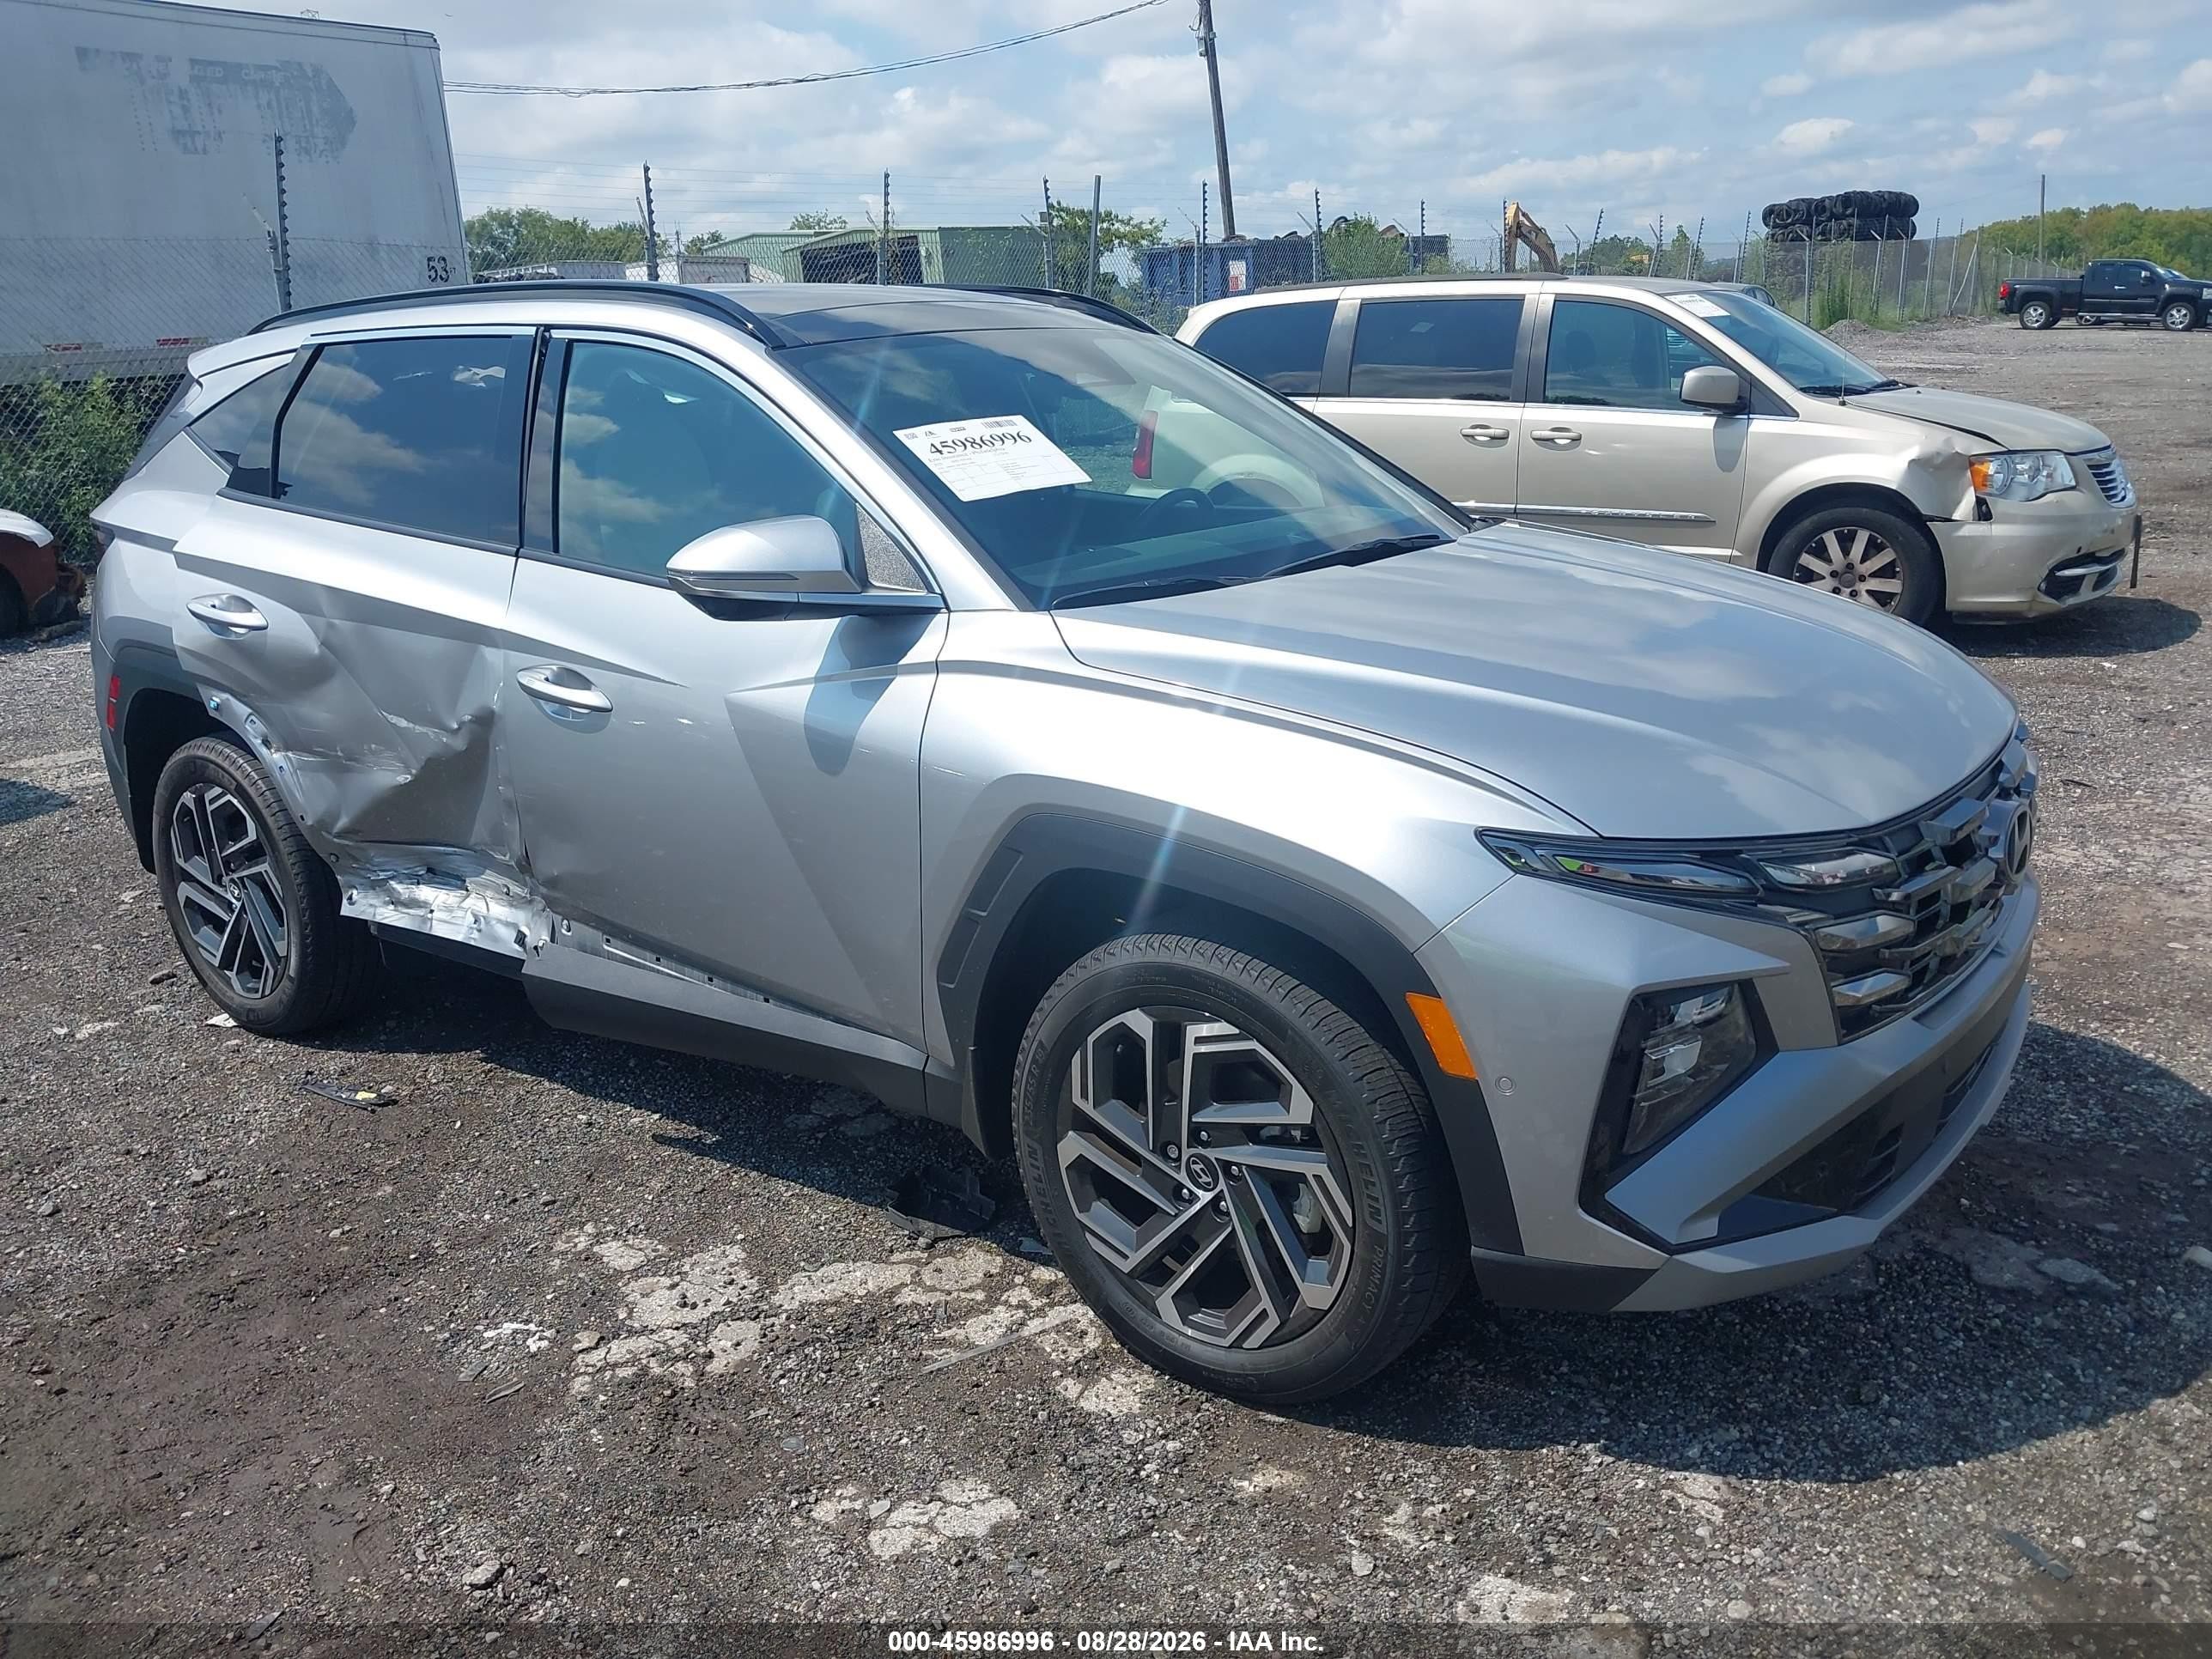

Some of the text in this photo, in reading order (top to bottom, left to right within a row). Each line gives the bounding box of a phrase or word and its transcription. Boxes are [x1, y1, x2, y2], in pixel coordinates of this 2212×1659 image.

[427, 256, 449, 283] 53
[929, 430, 1032, 455] 45986996
[1362, 1244, 1384, 1312] PRIMACY
